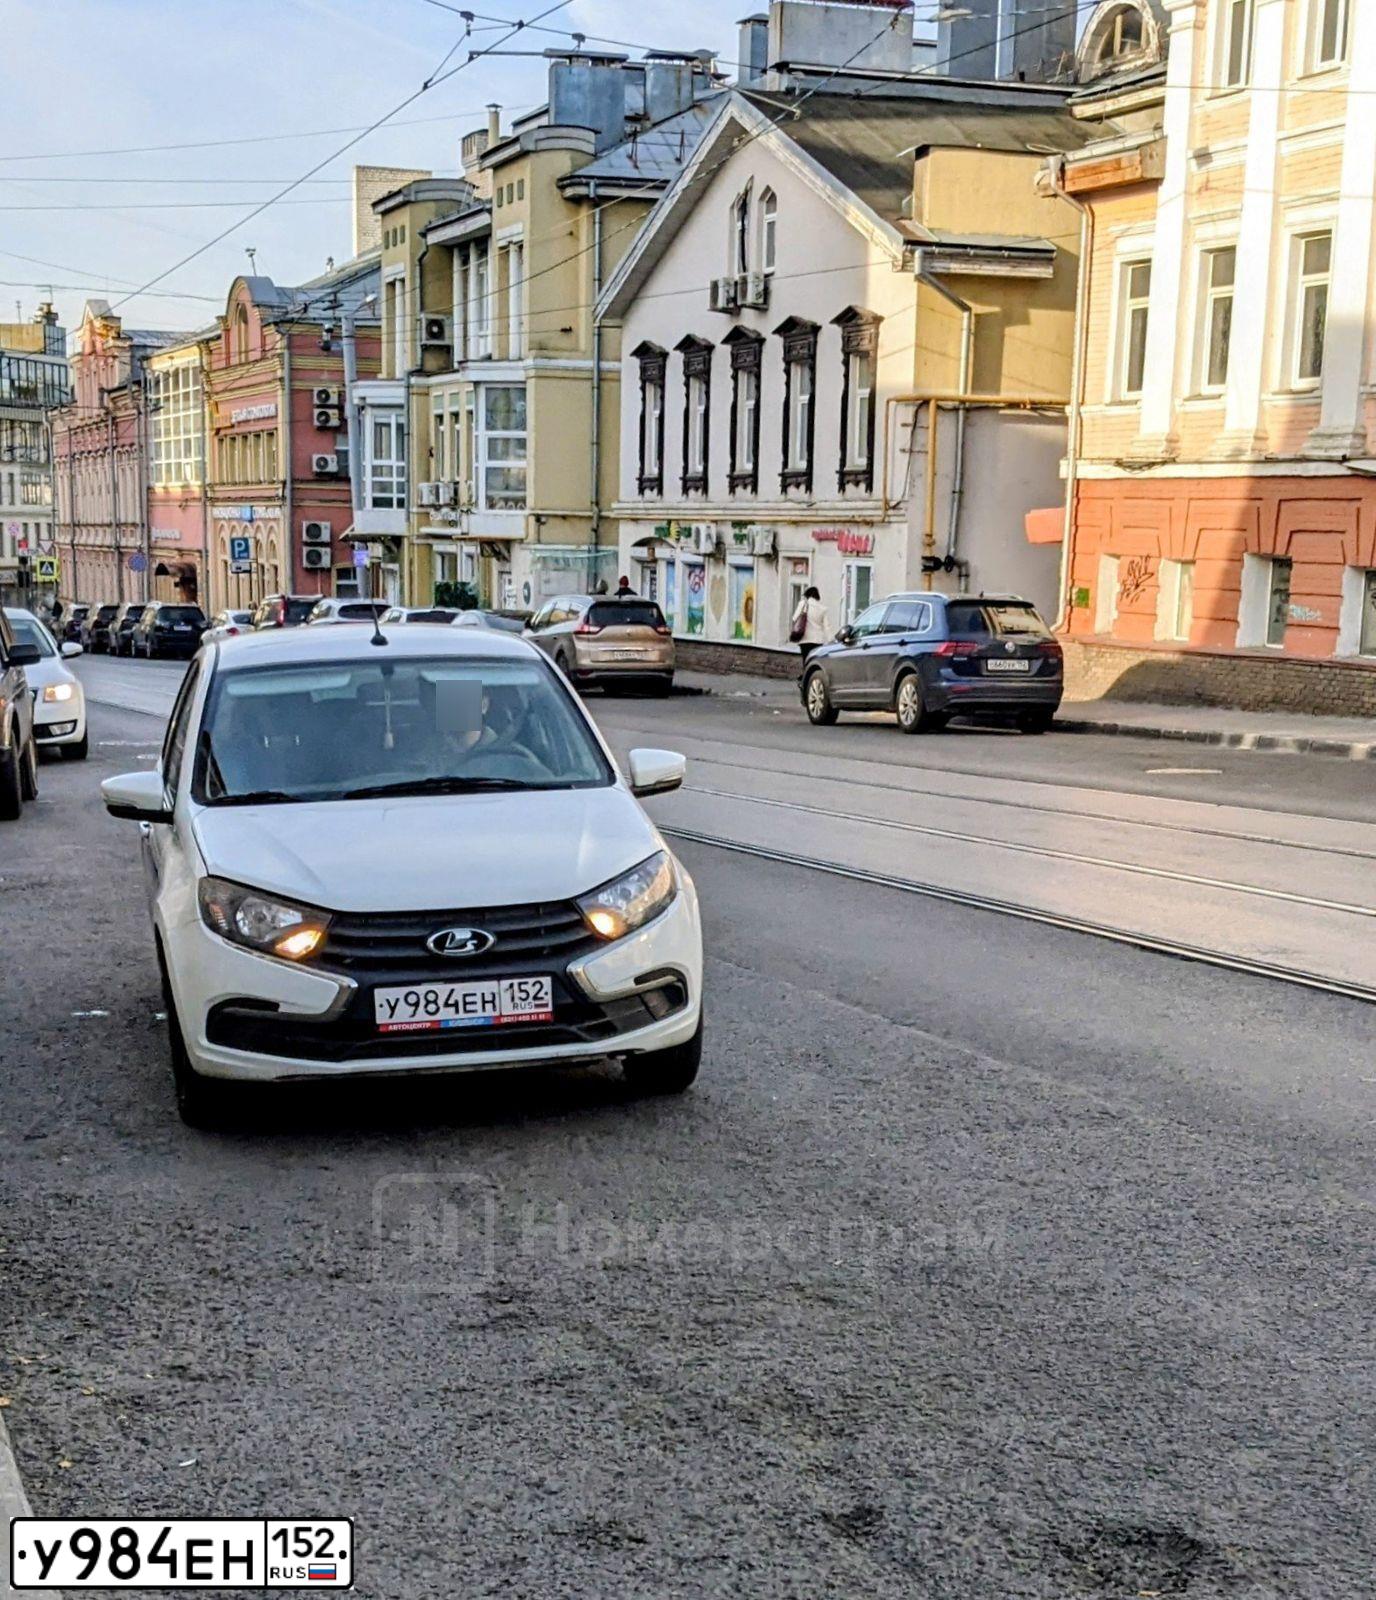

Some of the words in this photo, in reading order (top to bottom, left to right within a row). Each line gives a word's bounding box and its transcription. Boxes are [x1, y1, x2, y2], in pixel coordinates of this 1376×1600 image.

[234, 540, 246, 558] P
[385, 988, 497, 1018] У984ЕН
[505, 980, 544, 1002] 152
[512, 1001, 533, 1010] RUS
[388, 1022, 431, 1031] АВТОЦЕНТР
